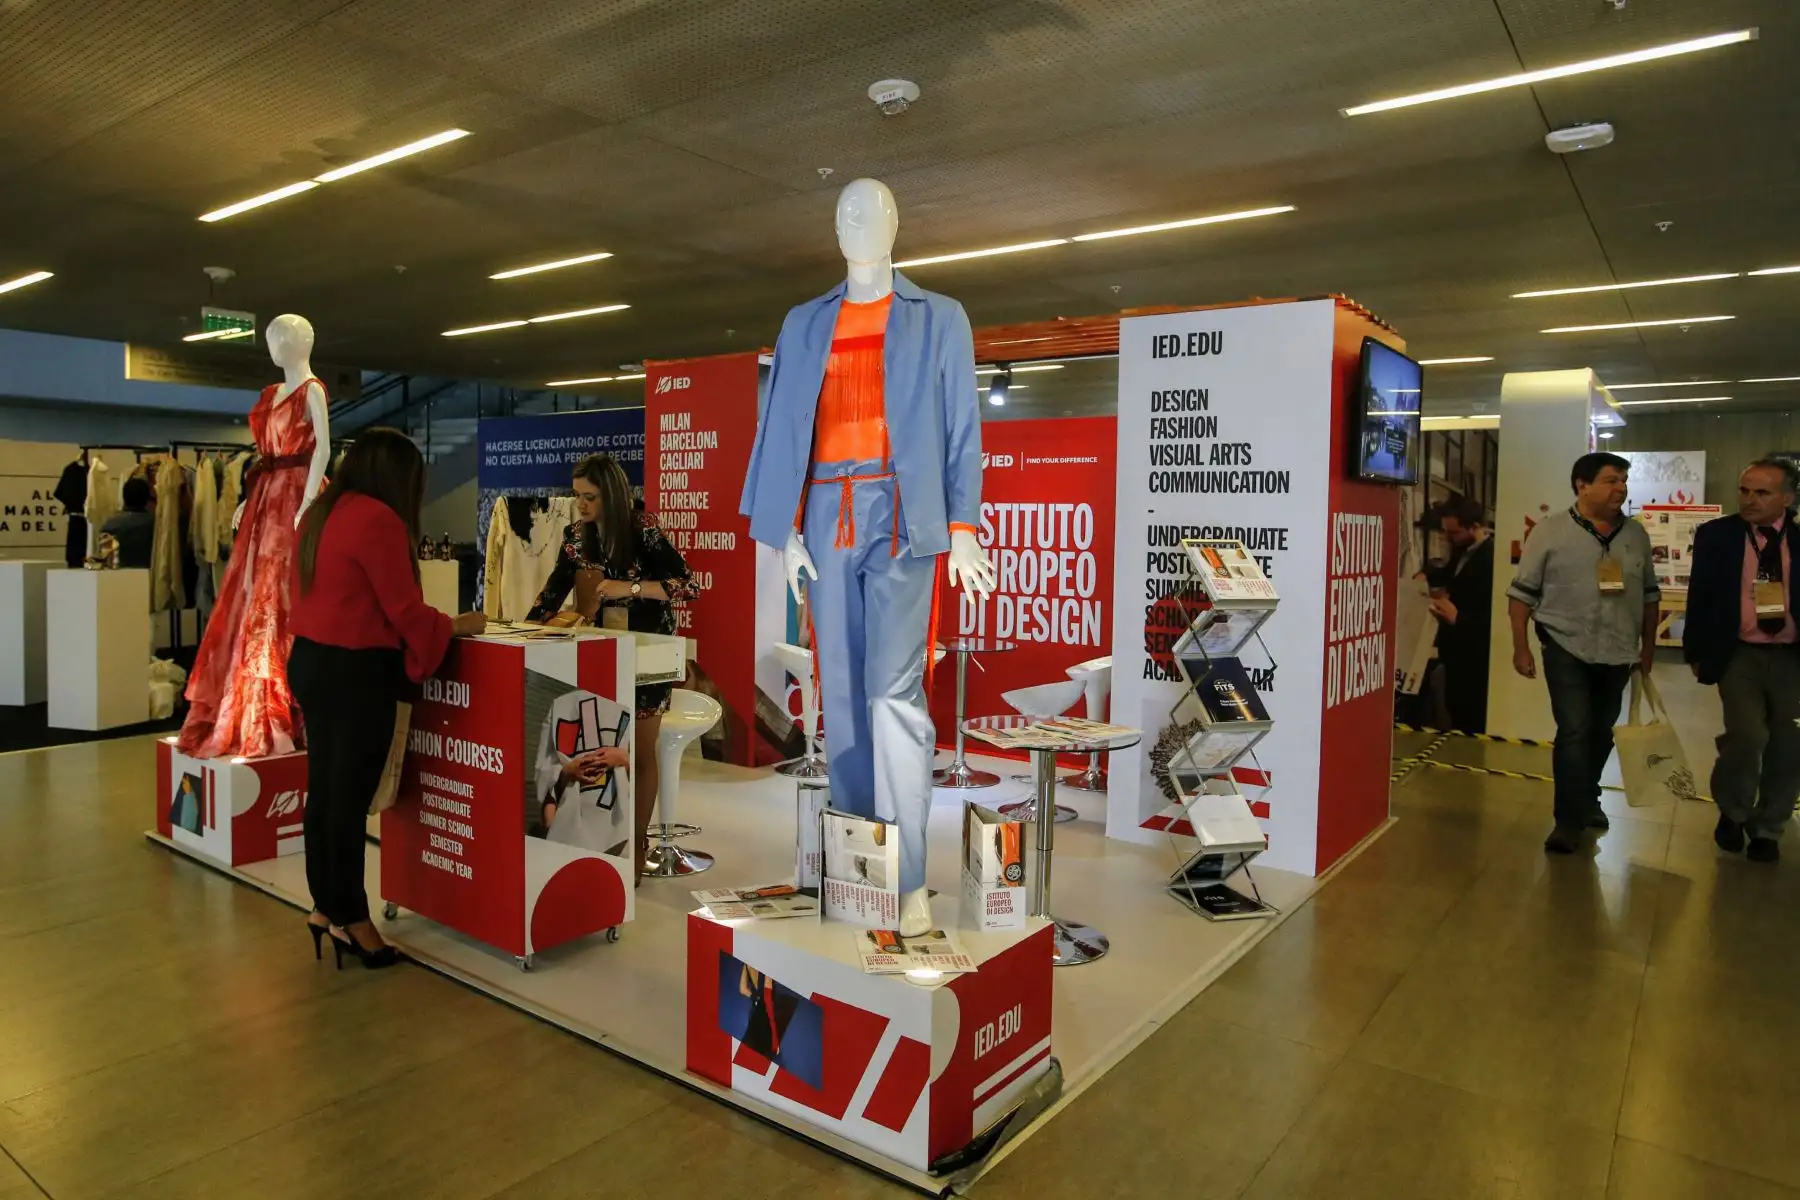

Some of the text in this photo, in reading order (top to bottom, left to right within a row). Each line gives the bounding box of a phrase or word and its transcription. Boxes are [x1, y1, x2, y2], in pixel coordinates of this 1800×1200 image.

[1152, 331, 1223, 359] IED.EDU
[673, 377, 691, 390] IED
[1151, 388, 1209, 412] DESIGN
[660, 412, 691, 431] MILAN
[1150, 416, 1218, 439] FASHION
[485, 433, 645, 452] HACERSE LICENCIATARIO DE COTTO
[660, 431, 718, 451] BARCELONA
[485, 455, 498, 466] NO
[500, 453, 533, 466] CUESTA
[535, 452, 562, 465] NADA
[660, 451, 704, 471] CAGLIARI
[991, 455, 1014, 467] IED
[1060, 456, 1098, 464] DIFFERENCE
[1150, 442, 1252, 466] VISUAL ARTS
[660, 471, 689, 490] COMO
[1148, 470, 1290, 493] COMMUNICATION
[660, 491, 709, 510] FLORENCE
[21, 521, 57, 532] DEL
[660, 511, 698, 529] MADRID
[978, 502, 1094, 550] STITUTO
[678, 532, 692, 550] DE
[694, 531, 736, 550] JANEIRO
[1331, 511, 1384, 576] ISTITUTO
[968, 549, 1097, 598] UROPEO
[1145, 578, 1210, 602] SUMME
[959, 592, 987, 637] DI
[996, 594, 1102, 647] DESIGN
[1330, 574, 1384, 643] EUROPEO
[1327, 632, 1386, 710] DI DESIGN
[422, 678, 470, 708] IED.EDU
[407, 727, 504, 775] SHION COURSES
[420, 771, 474, 799] UNDERGRADUATE
[422, 791, 471, 818] POSTGRADUATE
[419, 810, 475, 840] SUMMER SCHOOL
[430, 833, 463, 856] SEMESTER
[421, 850, 473, 880] ACADEMIC YEAR
[986, 891, 1011, 900] ISTITUTO
[986, 899, 1012, 908] EUROPEO
[986, 906, 1014, 916] DI DESIGN
[974, 1002, 1022, 1061] IED.EDU
